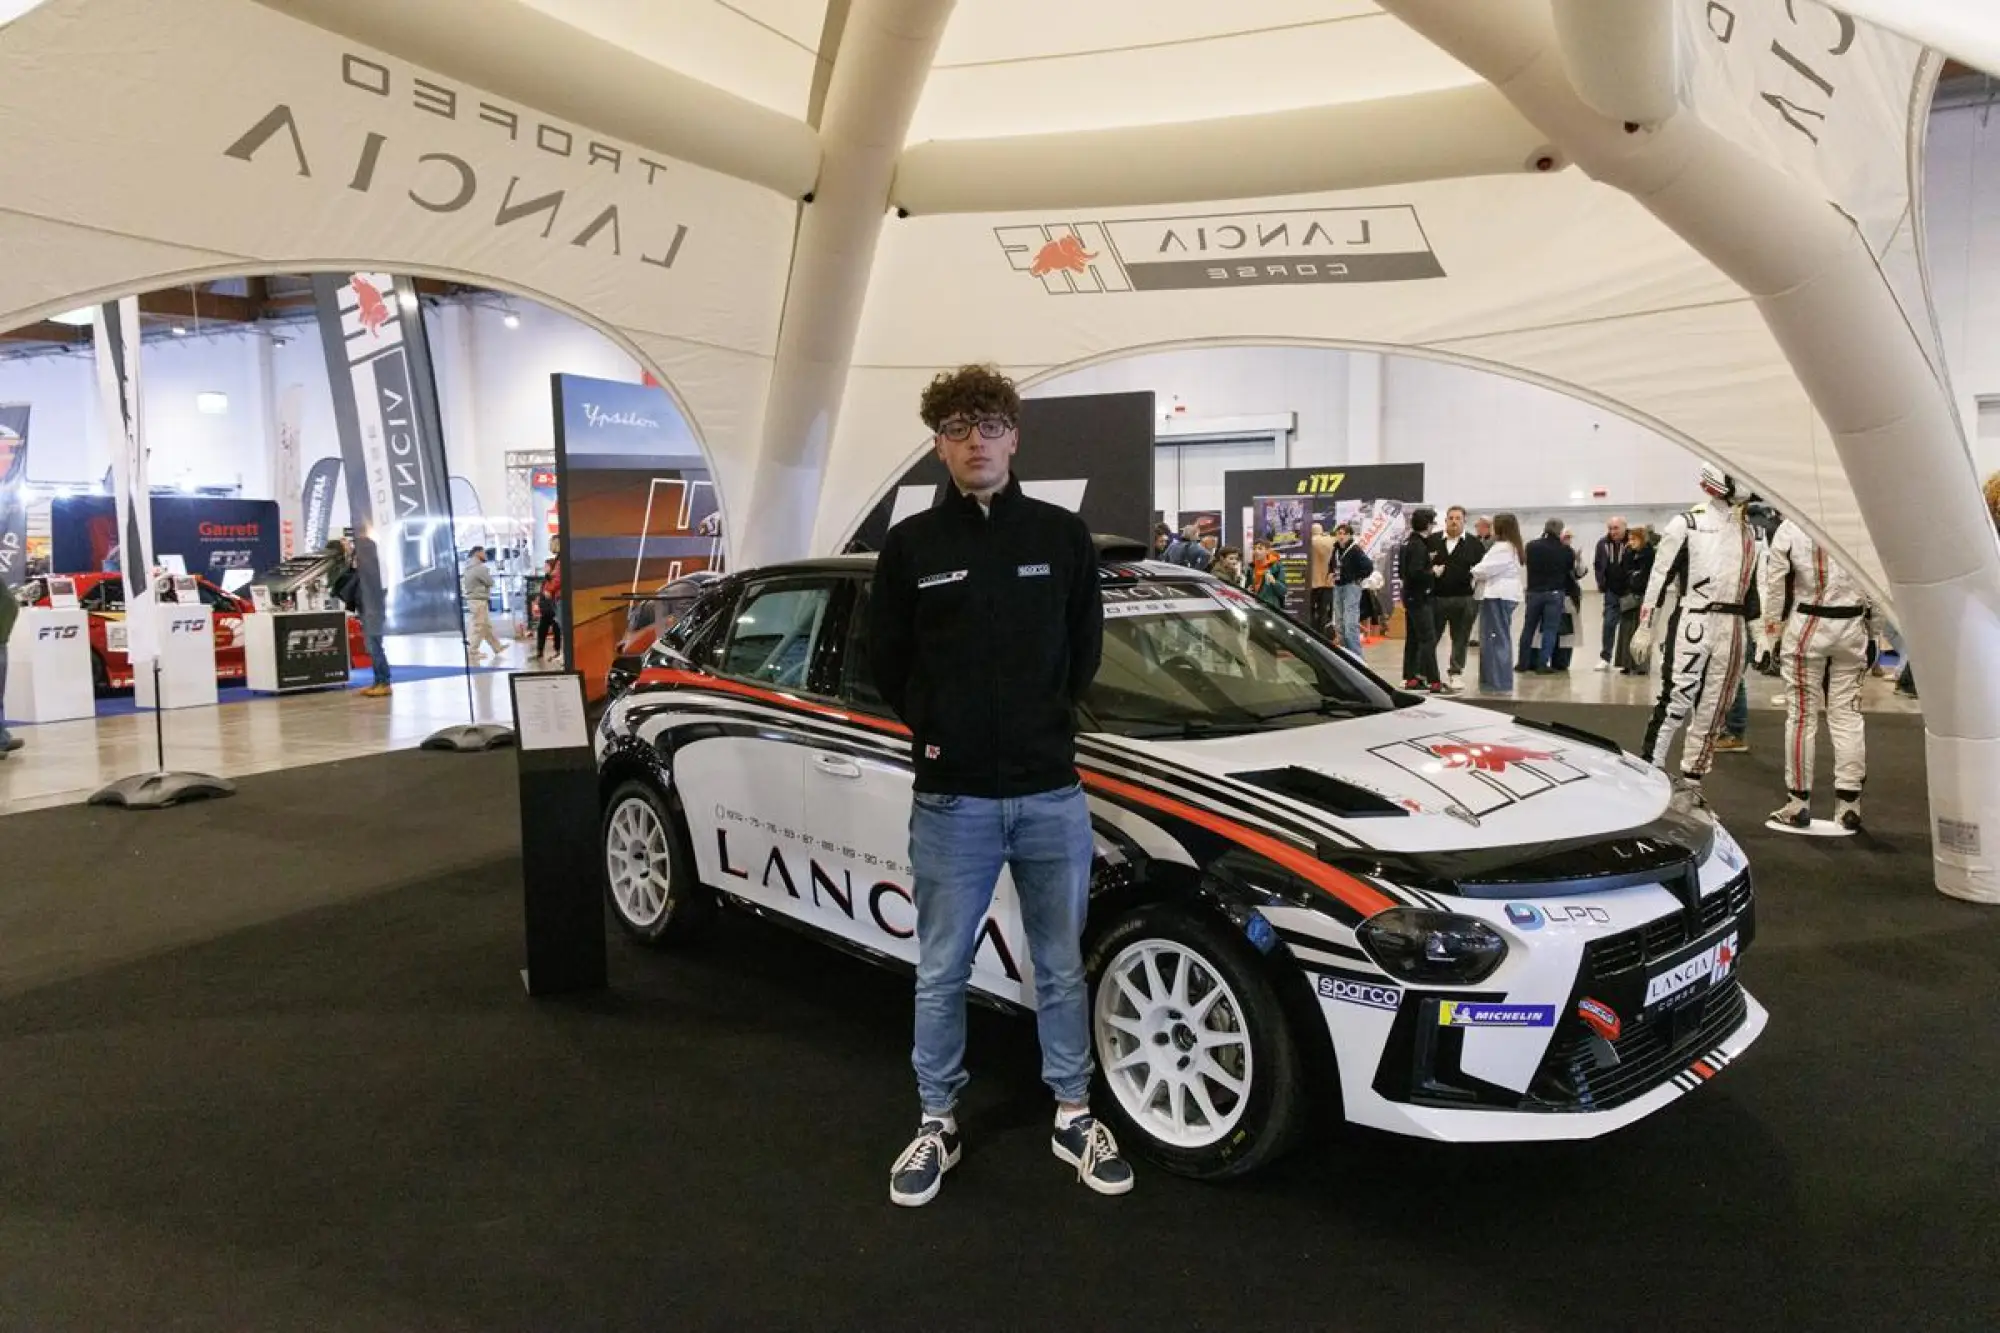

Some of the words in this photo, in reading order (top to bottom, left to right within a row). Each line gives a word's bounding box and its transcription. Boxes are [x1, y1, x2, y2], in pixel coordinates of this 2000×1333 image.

[581, 402, 660, 428] Ypsilon
[1296, 472, 1345, 494] #117
[198, 521, 259, 536] Garrett
[1101, 585, 1188, 600] NCIA
[38, 626, 79, 640] FTS
[172, 619, 205, 634] FTS
[717, 828, 1023, 983] LANCA
[1652, 957, 1708, 998] LANCIA
[1319, 976, 1398, 1005] sparco
[1474, 1011, 1543, 1022] MICHELIN
